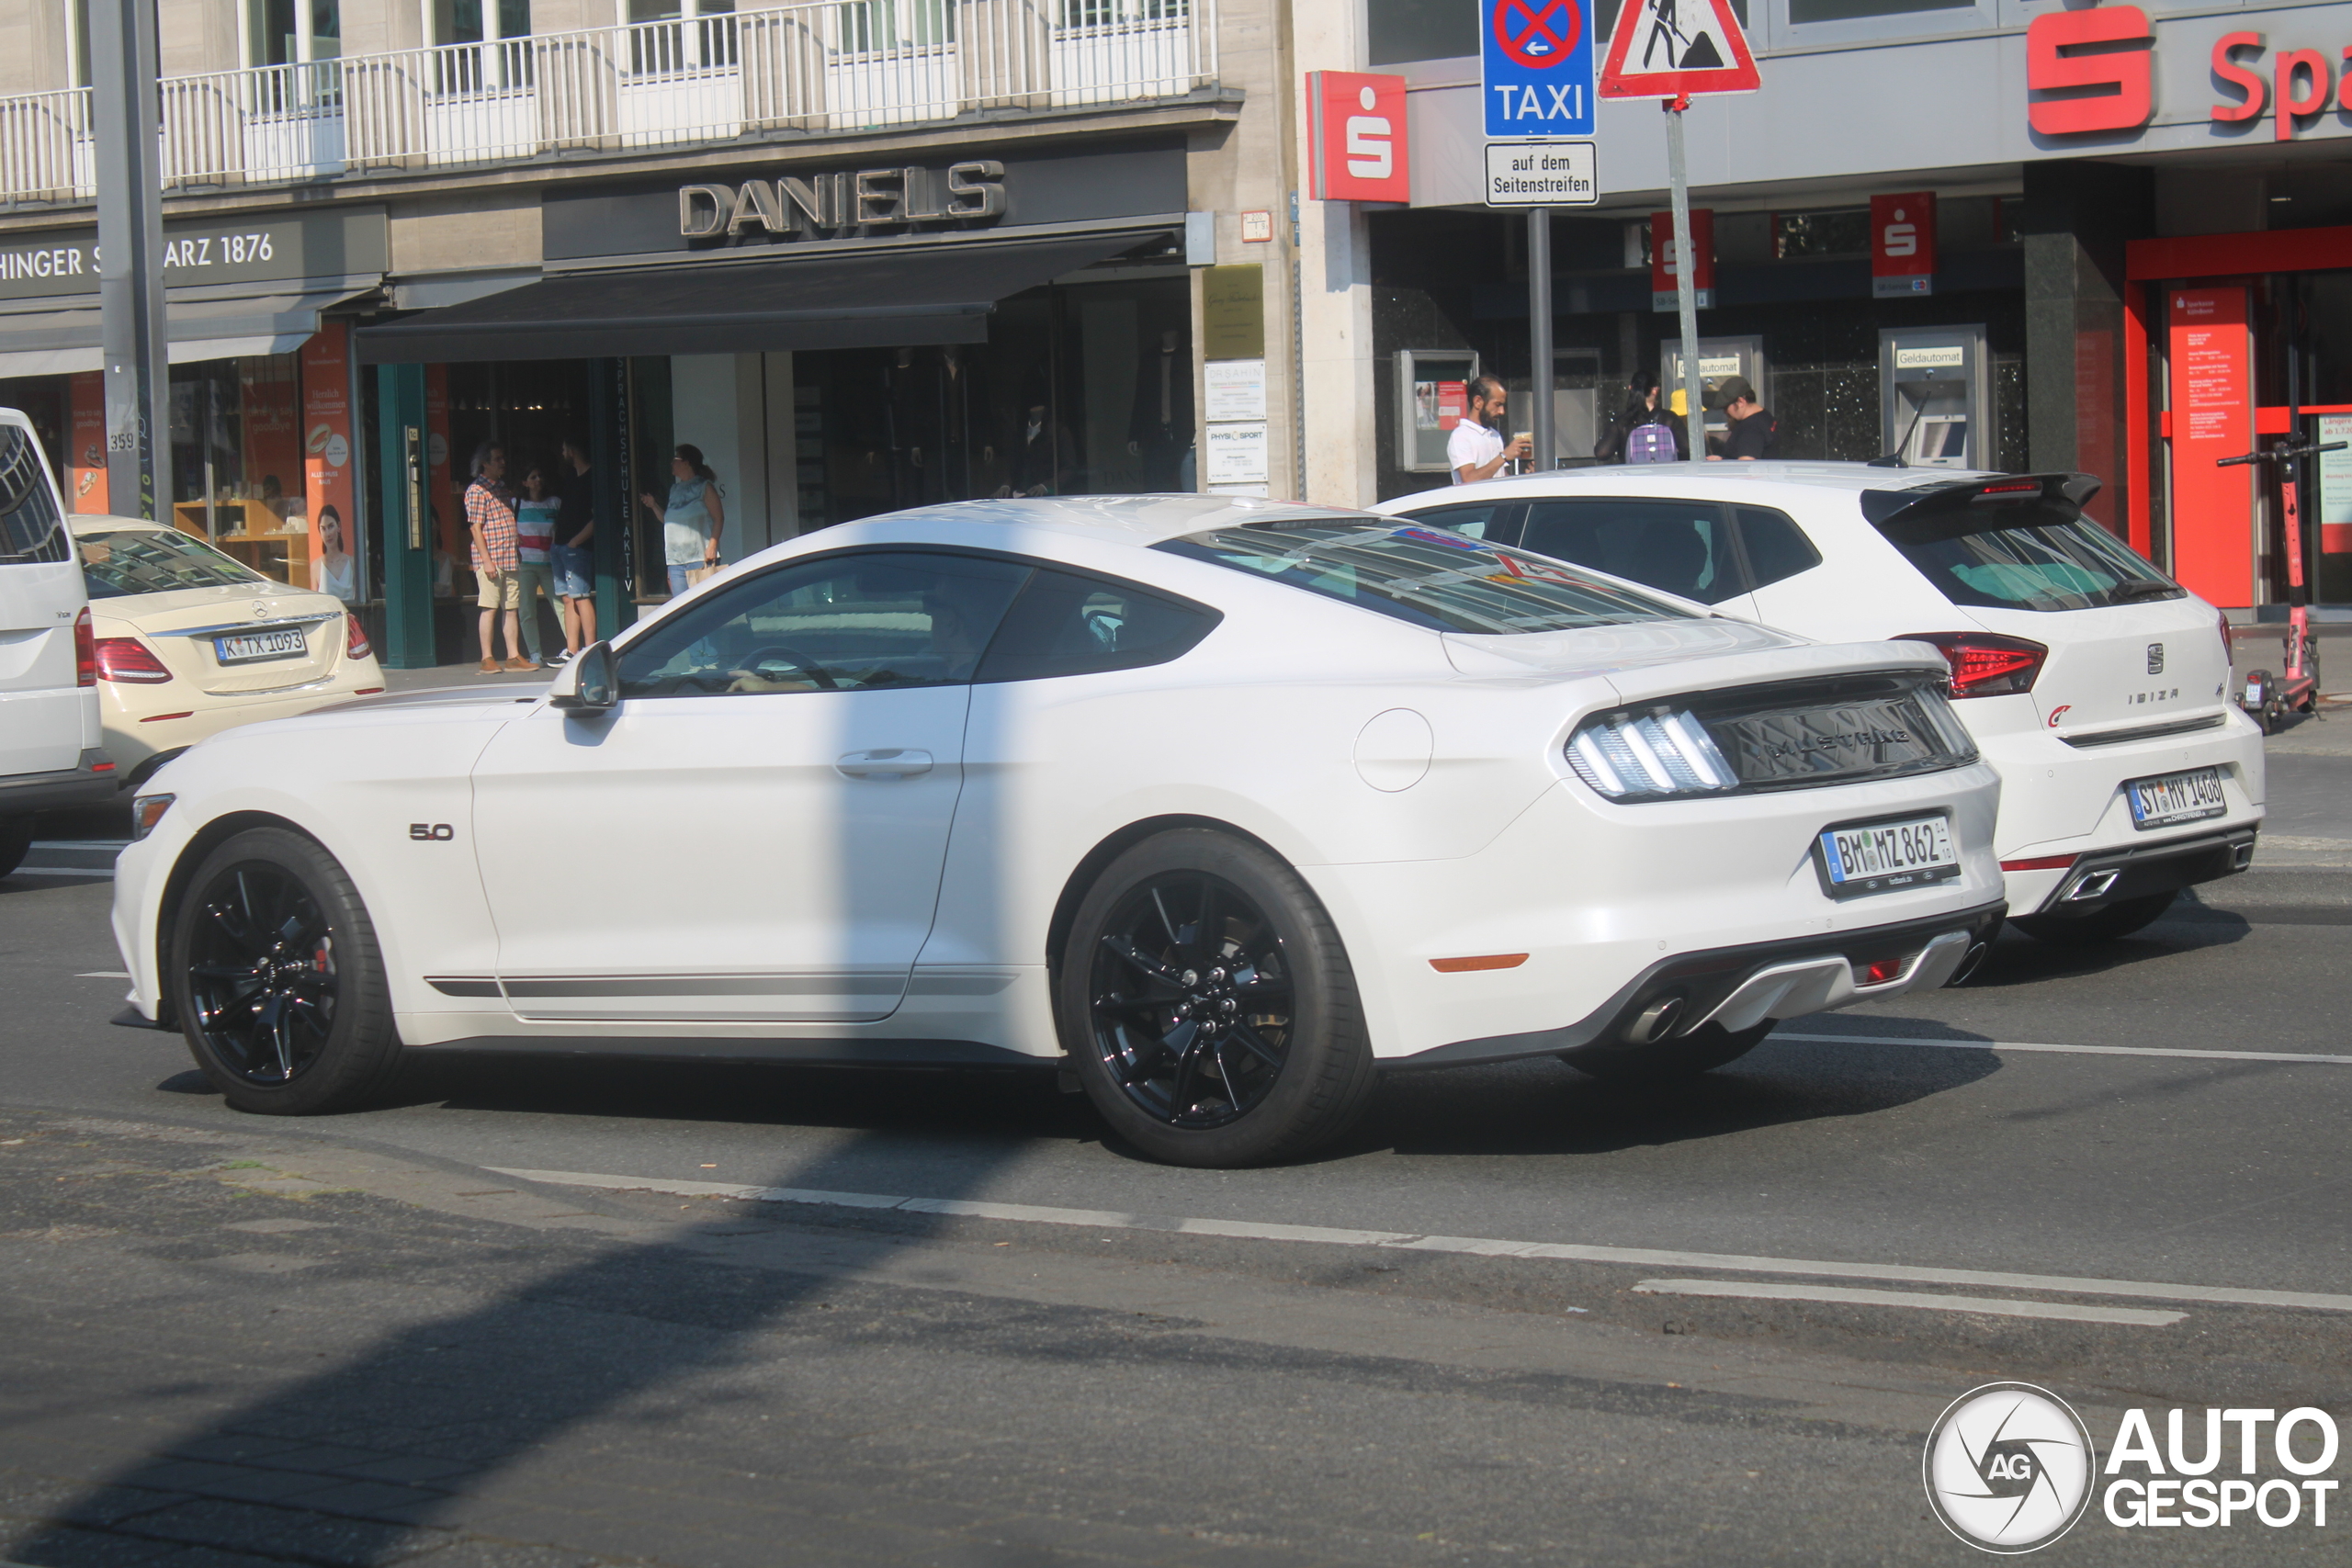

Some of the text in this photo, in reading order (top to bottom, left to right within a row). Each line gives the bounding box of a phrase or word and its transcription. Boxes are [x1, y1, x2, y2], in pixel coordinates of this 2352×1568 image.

[1494, 85, 1582, 120] TAXI
[1512, 154, 1570, 171] auf dem
[1494, 175, 1589, 193] Seitenstreifen
[679, 160, 1006, 238] DANIELS
[220, 232, 273, 264] 1876
[1899, 352, 1960, 364] Geldautomat
[312, 389, 339, 399] Herzlich
[306, 400, 345, 410] willkommen
[2324, 418, 2351, 426] Längere
[110, 433, 134, 450] 359
[623, 526, 632, 592] AKTIV
[224, 639, 237, 657] K
[243, 636, 265, 654] TX
[266, 632, 302, 652] 1093
[2128, 688, 2178, 705] IBIZA
[2139, 783, 2160, 815] ST
[2165, 778, 2187, 809] MY
[2188, 773, 2221, 806] 1408
[409, 823, 454, 841] 5.0
[1837, 834, 1868, 874] BM
[1873, 829, 1904, 869] MZ
[1901, 824, 1939, 864] 862
